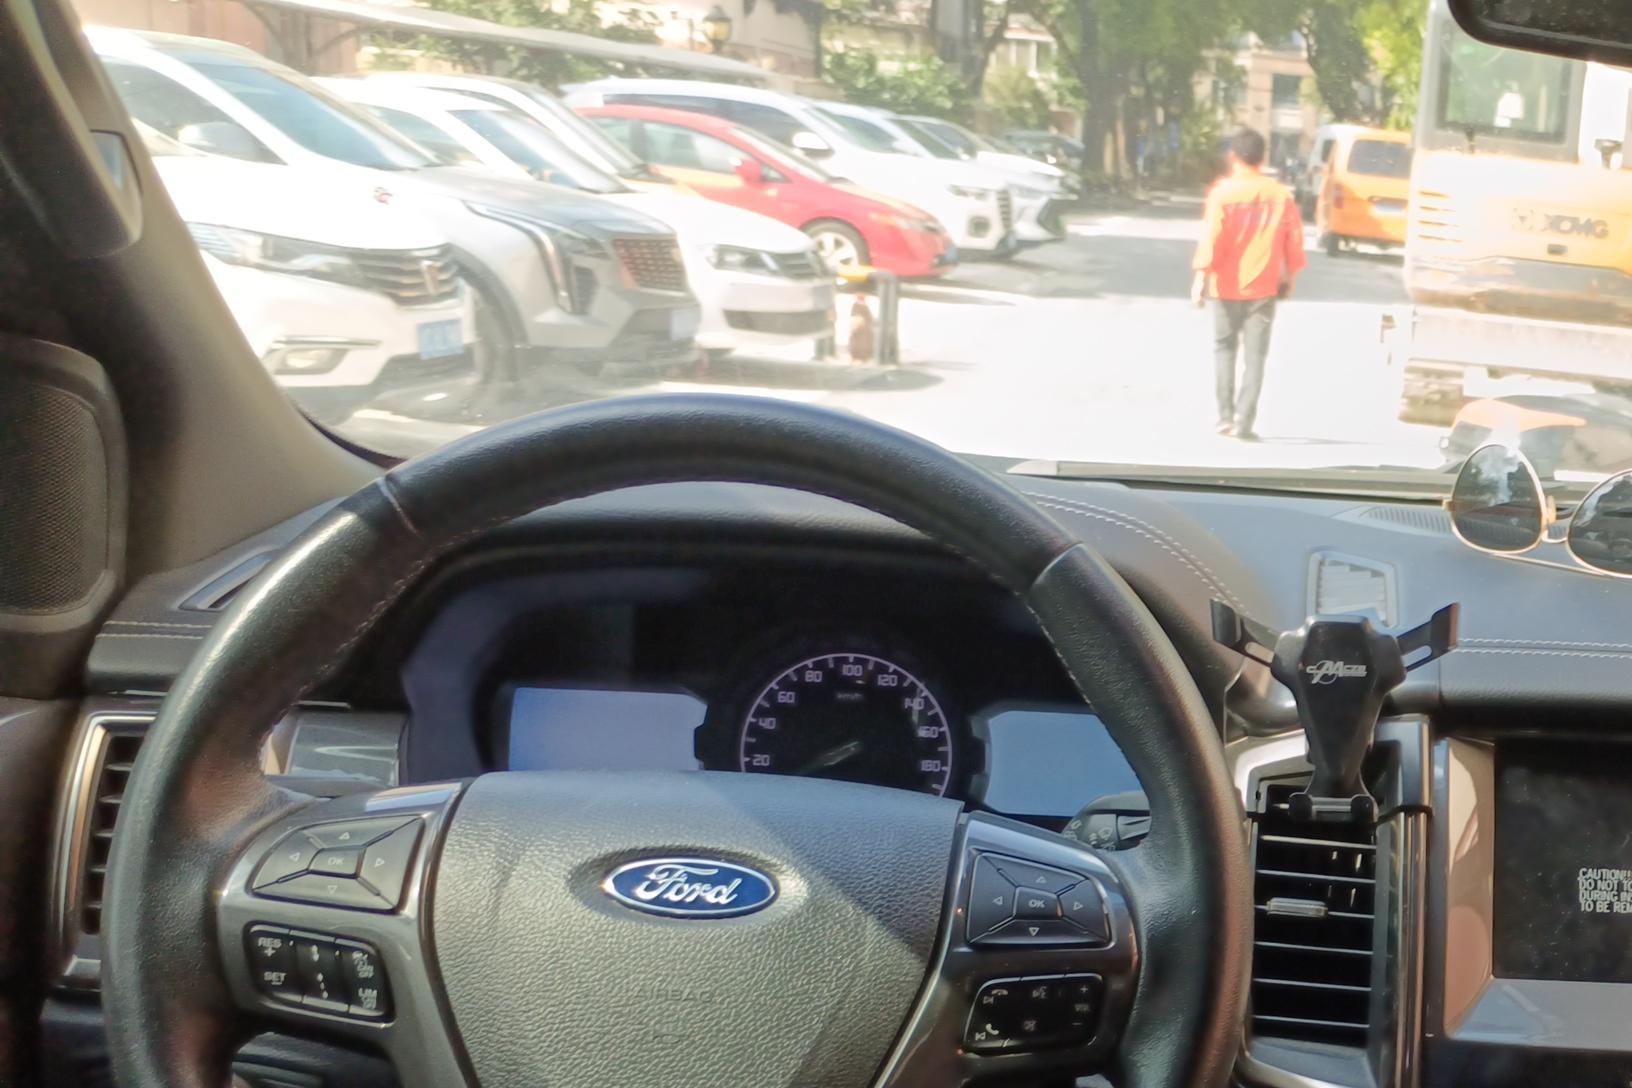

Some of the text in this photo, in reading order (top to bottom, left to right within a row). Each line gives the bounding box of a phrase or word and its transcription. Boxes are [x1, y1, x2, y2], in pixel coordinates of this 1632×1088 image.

[805, 670, 822, 683] 80
[842, 664, 863, 677] 100
[877, 674, 898, 687] 120
[777, 691, 796, 704] 60
[904, 698, 924, 710] 140
[758, 717, 776, 730] 40
[918, 726, 939, 738] 160
[752, 753, 770, 767] 20
[921, 759, 941, 773] 180
[327, 857, 344, 866] OK
[632, 864, 743, 905] Ford
[1579, 879, 1595, 891] DO
[1597, 880, 1619, 892] NOT
[1579, 890, 1618, 902] DURING
[1028, 899, 1046, 908] OK
[1580, 901, 1594, 912] TO
[1596, 901, 1611, 913] BE
[257, 936, 282, 948] RES
[263, 971, 287, 983] SET
